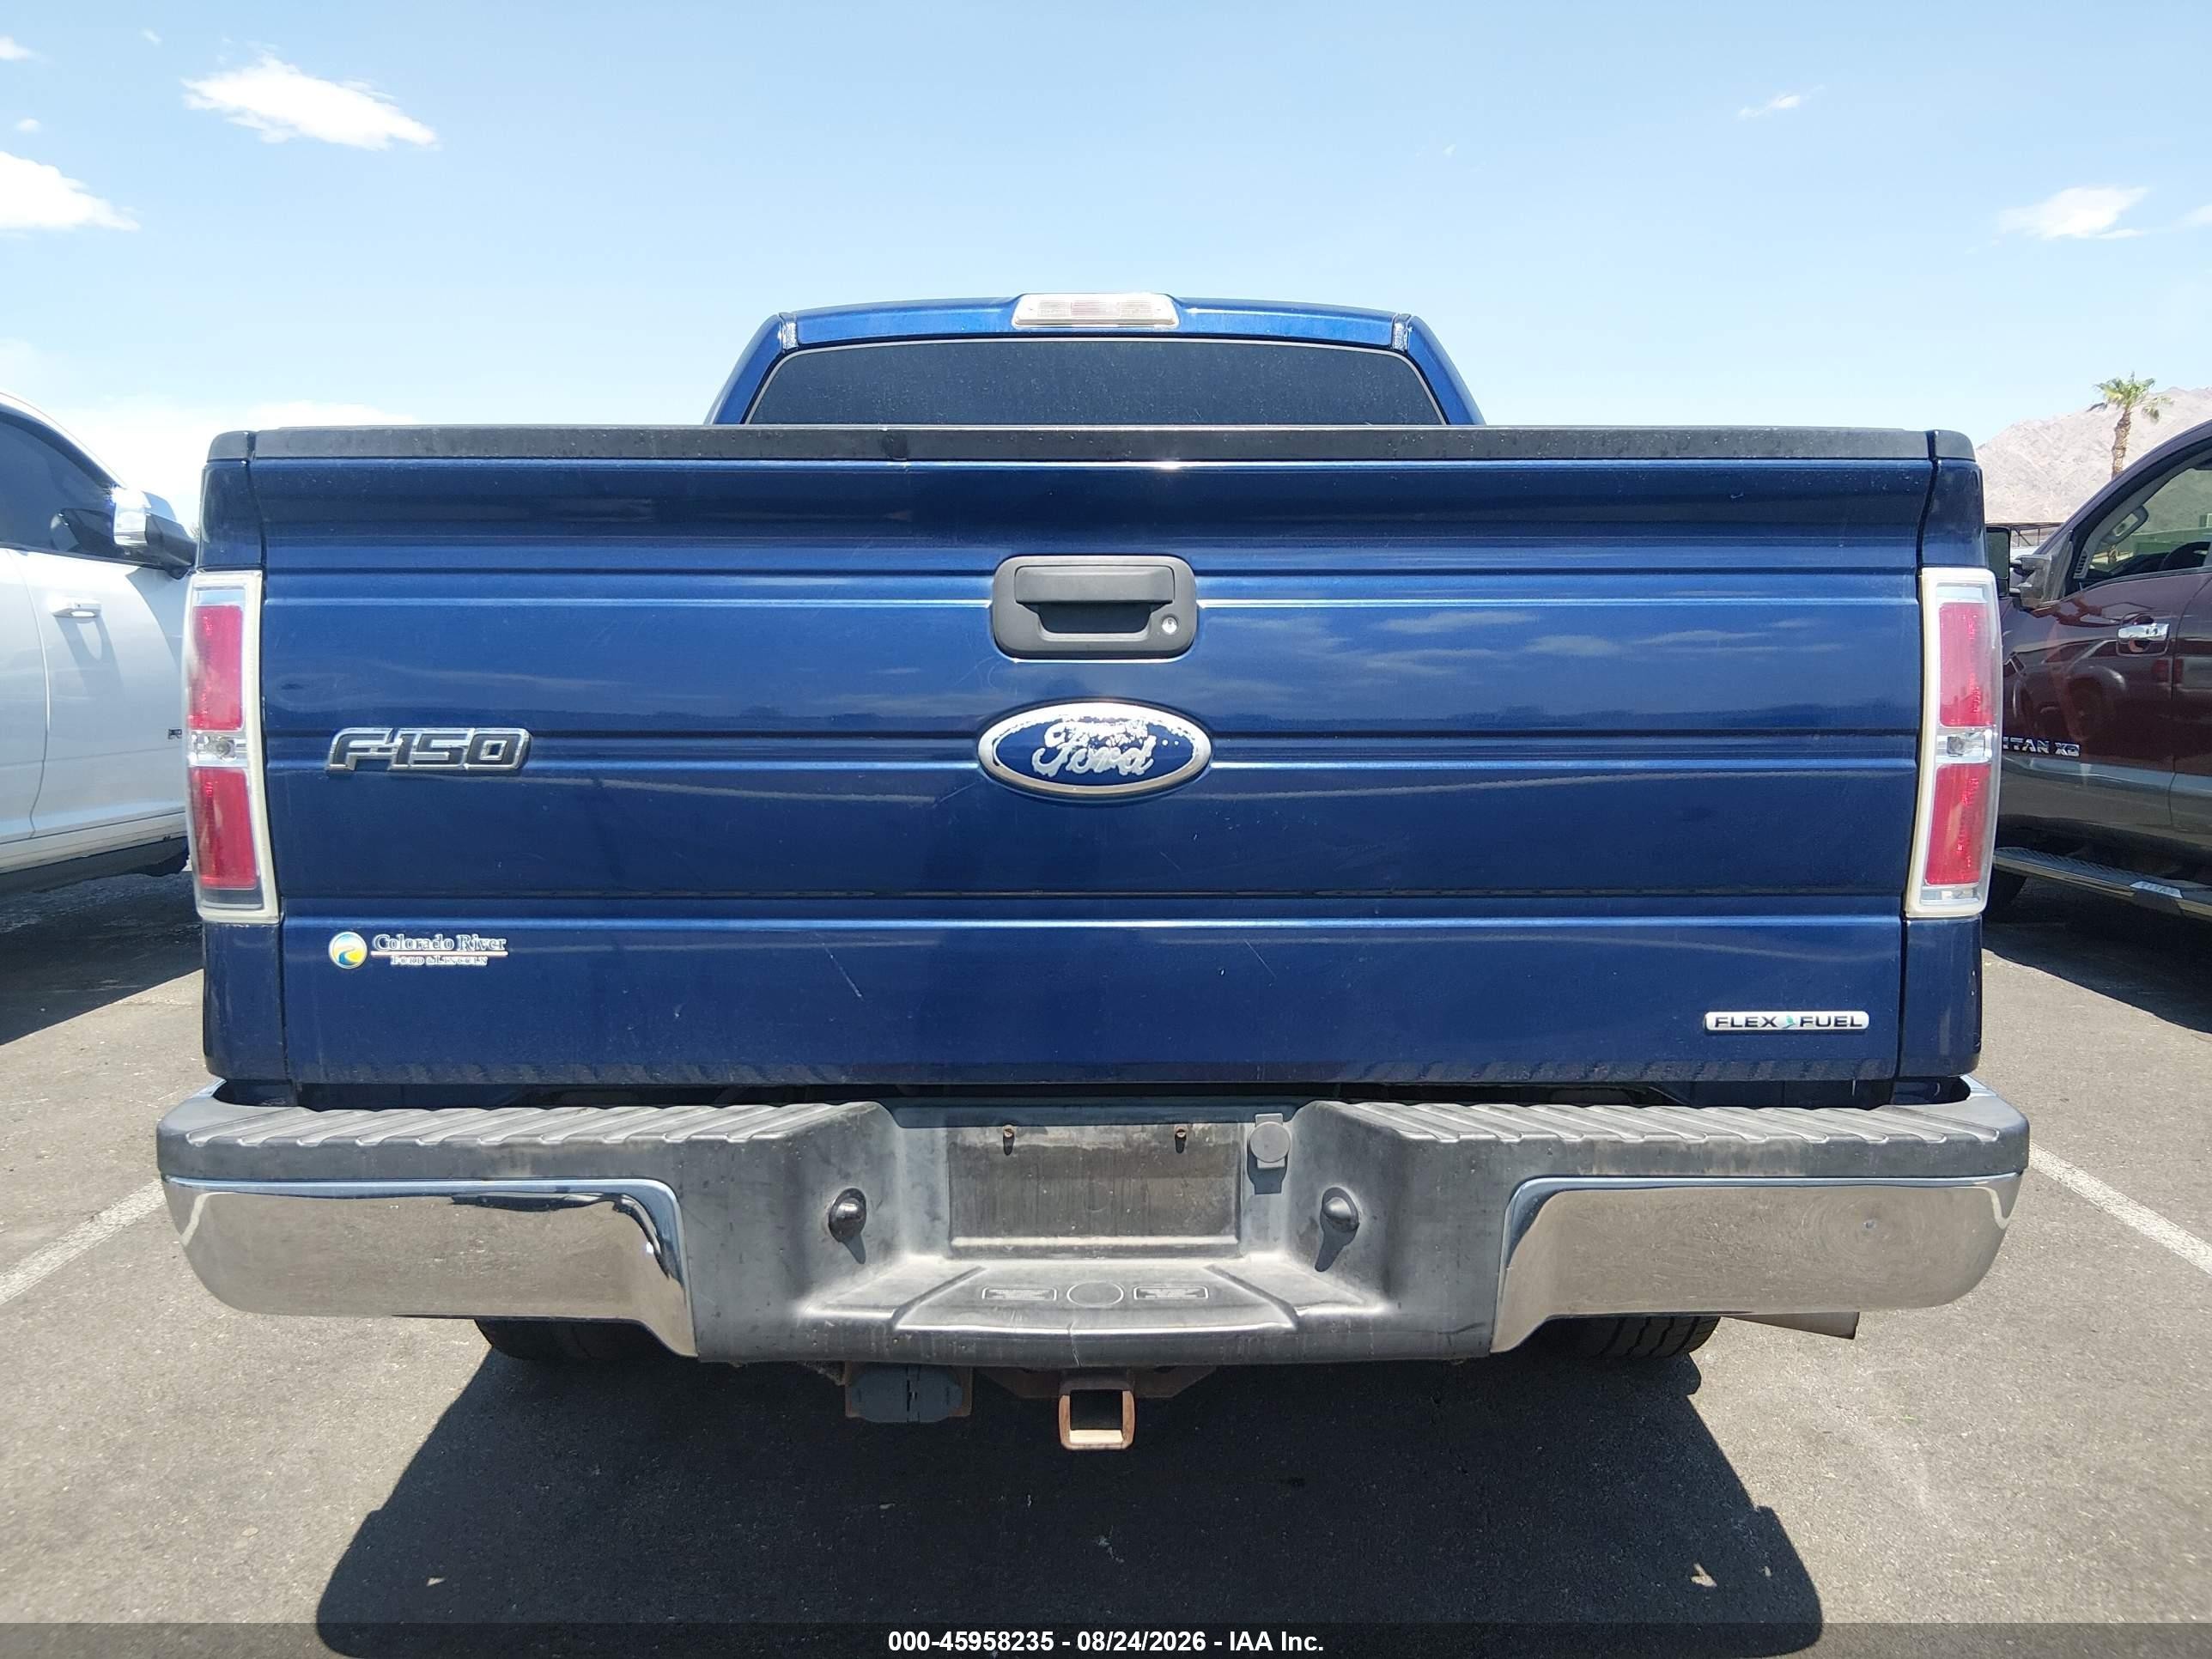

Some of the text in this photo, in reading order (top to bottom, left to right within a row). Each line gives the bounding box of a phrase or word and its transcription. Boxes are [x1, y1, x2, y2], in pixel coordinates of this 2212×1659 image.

[325, 727, 532, 771] F-150
[1032, 720, 1157, 776] Ford
[2002, 736, 2080, 757] ITAN XD
[373, 933, 507, 951] Colorado River
[1715, 1016, 1863, 1028] FLEX FUEL
